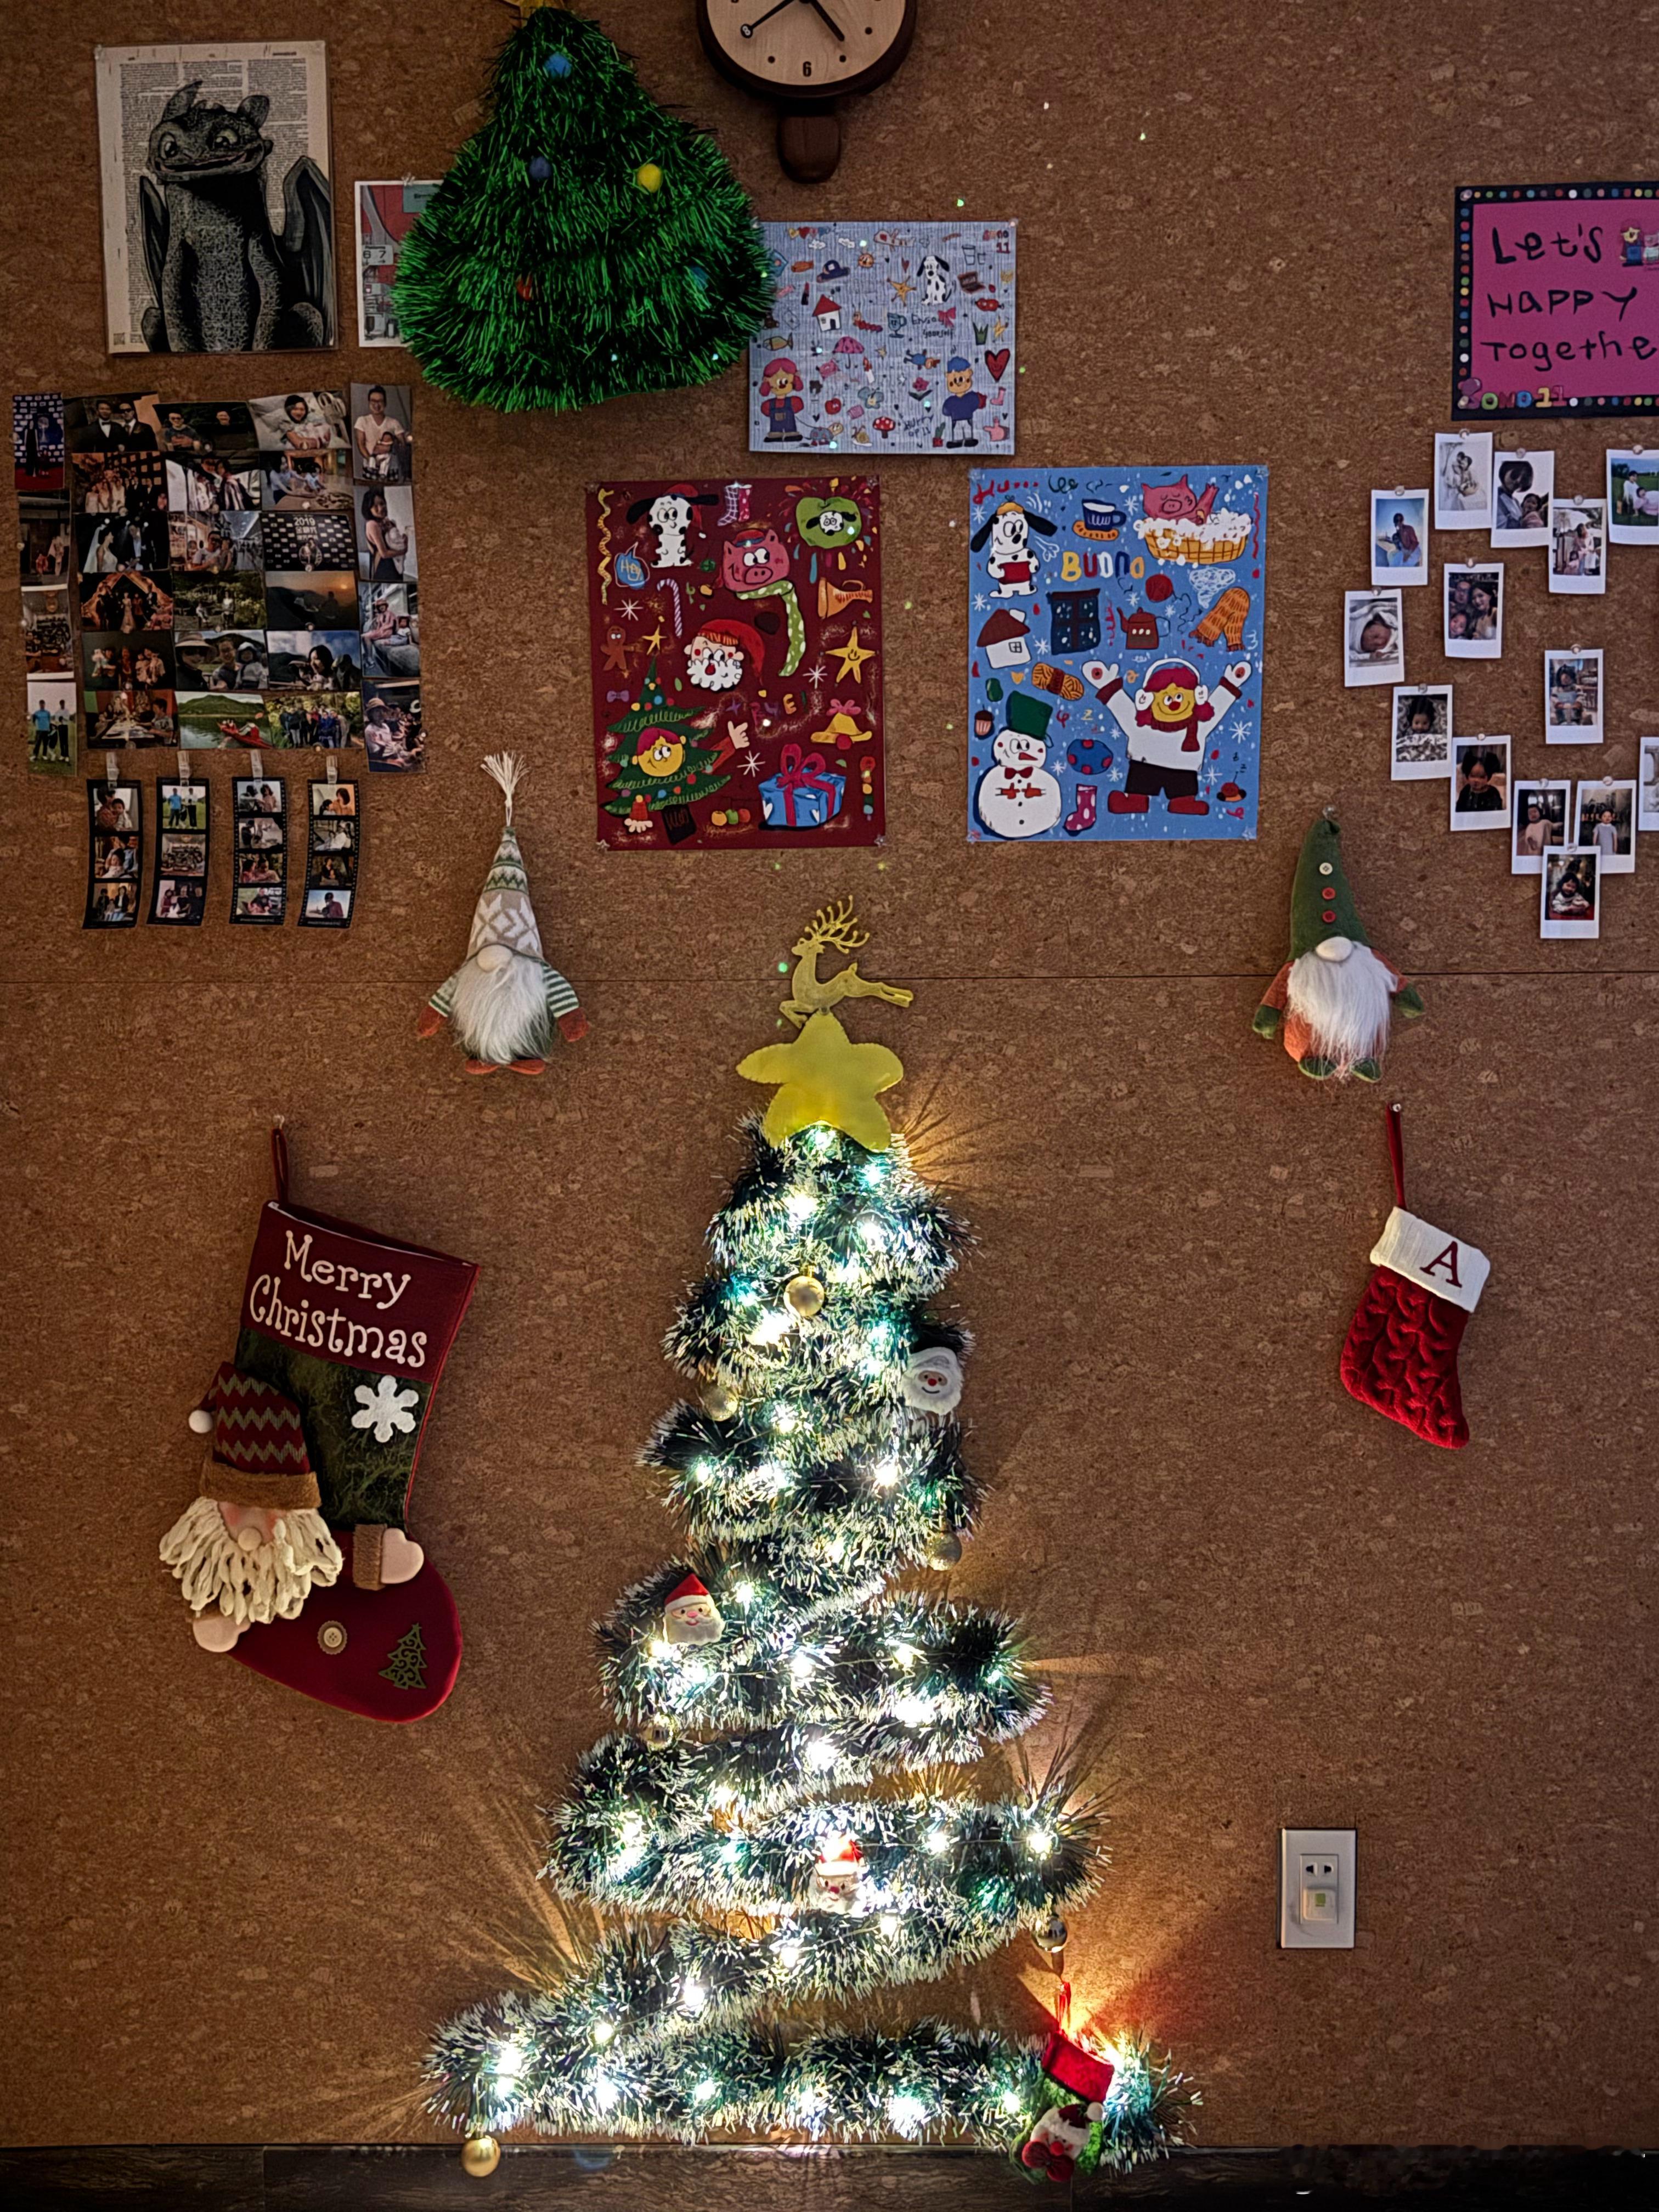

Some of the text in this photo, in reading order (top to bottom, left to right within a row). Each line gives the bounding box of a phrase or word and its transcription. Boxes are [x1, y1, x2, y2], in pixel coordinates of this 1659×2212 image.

[803, 61, 811, 77] 6
[363, 250, 386, 258] 6 7
[1492, 223, 1603, 264] Let's
[294, 517, 316, 526] 2019
[284, 1230, 411, 1310] Merry
[1419, 1240, 1462, 1288] A
[250, 1274, 427, 1368] Christmas
